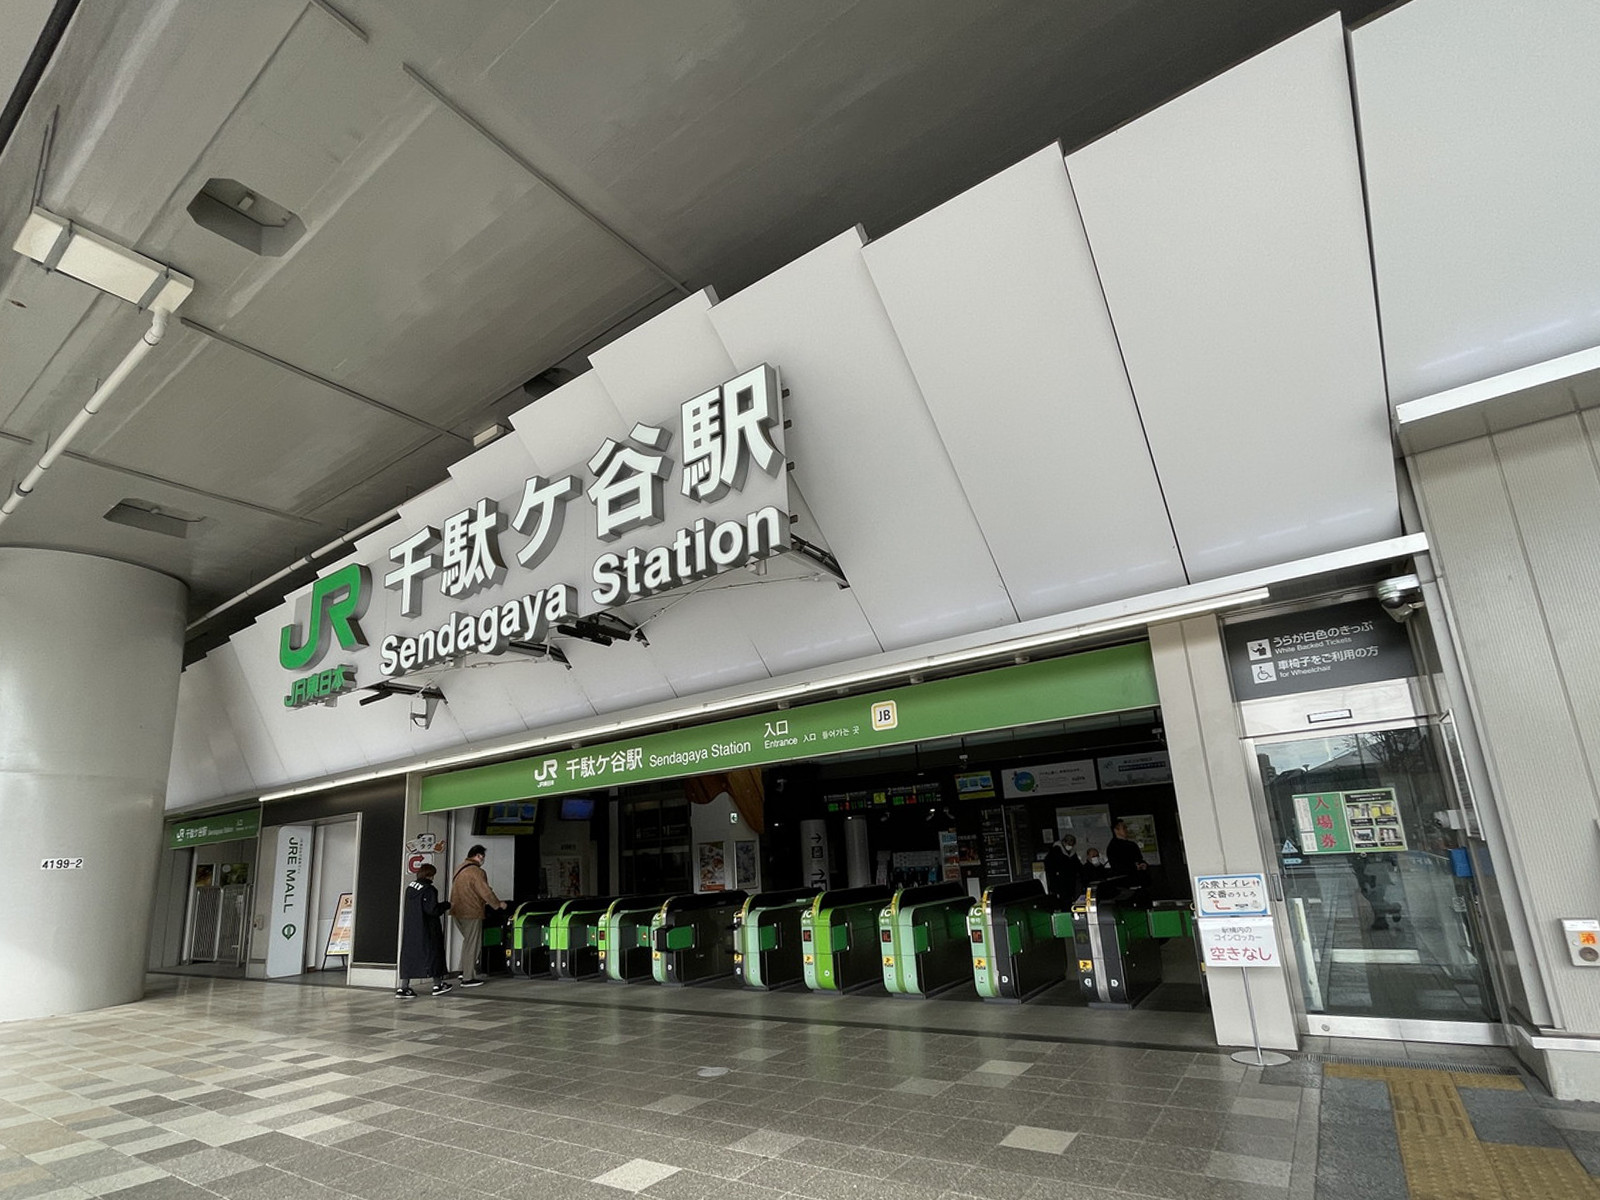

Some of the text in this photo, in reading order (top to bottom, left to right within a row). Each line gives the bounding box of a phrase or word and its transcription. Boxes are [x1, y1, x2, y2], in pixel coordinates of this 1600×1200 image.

[379, 505, 790, 677] Sendagaya Station
[280, 563, 371, 671] JR
[1275, 637, 1352, 655] White Backed Tickets
[1278, 645, 1379, 670] 車椅子をご利用の方
[1291, 665, 1331, 676] Wheelchair
[284, 664, 356, 707] JR東日本
[878, 709, 891, 722] JB
[763, 720, 788, 738] 入口
[764, 736, 798, 749] Entrance
[803, 733, 817, 742] 入口
[649, 739, 751, 768] Sendagaya Station
[534, 758, 558, 781] JR
[1315, 796, 1337, 848] 入場券
[41, 858, 84, 869] 4199-2
[283, 836, 298, 914] JRE MALL
[1200, 880, 1250, 889] 公衆トイレ
[1208, 891, 1256, 899] 交番のうしろ
[802, 909, 812, 918] IC
[880, 908, 892, 917] IC
[970, 906, 982, 916] IC
[1210, 947, 1272, 961] 空きなし
